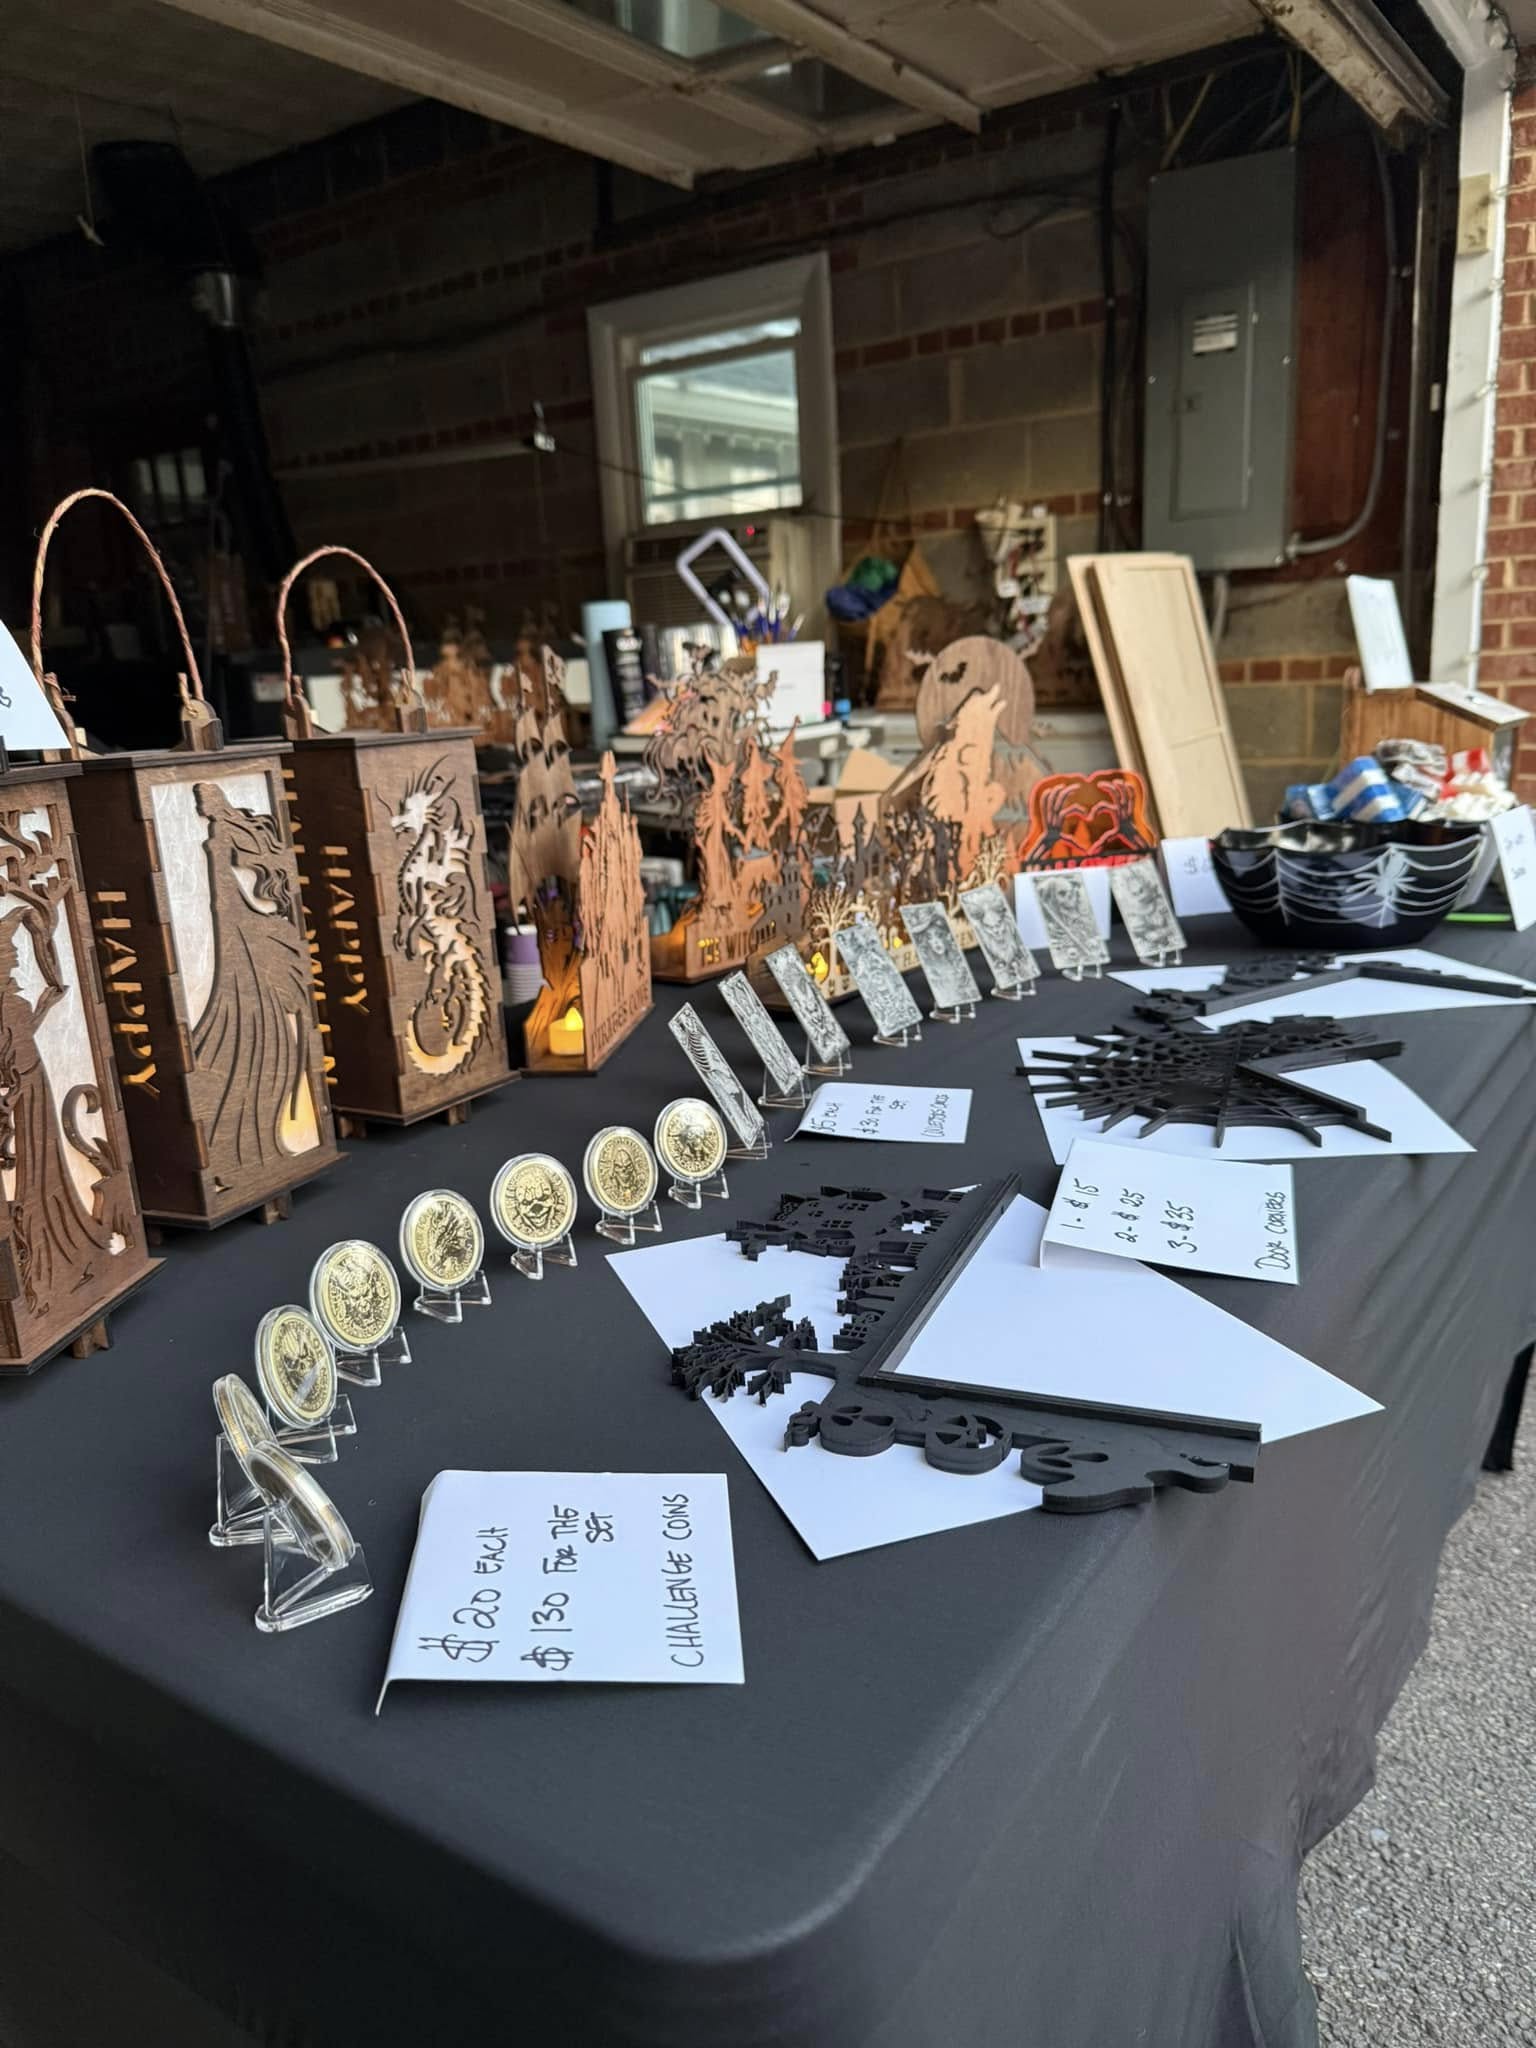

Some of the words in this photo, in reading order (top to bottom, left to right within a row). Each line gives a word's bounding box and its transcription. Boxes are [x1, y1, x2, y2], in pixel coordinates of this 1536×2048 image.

[323, 846, 370, 1012] HAPPY
[97, 891, 160, 1098] HAPPY
[547, 1505, 579, 1538] THE
[586, 1512, 613, 1543] SET
[661, 1493, 690, 1540] COINS
[474, 1526, 508, 1574] EACH
[543, 1545, 577, 1574] FOR
[661, 1550, 704, 1667] CHALLENGE
